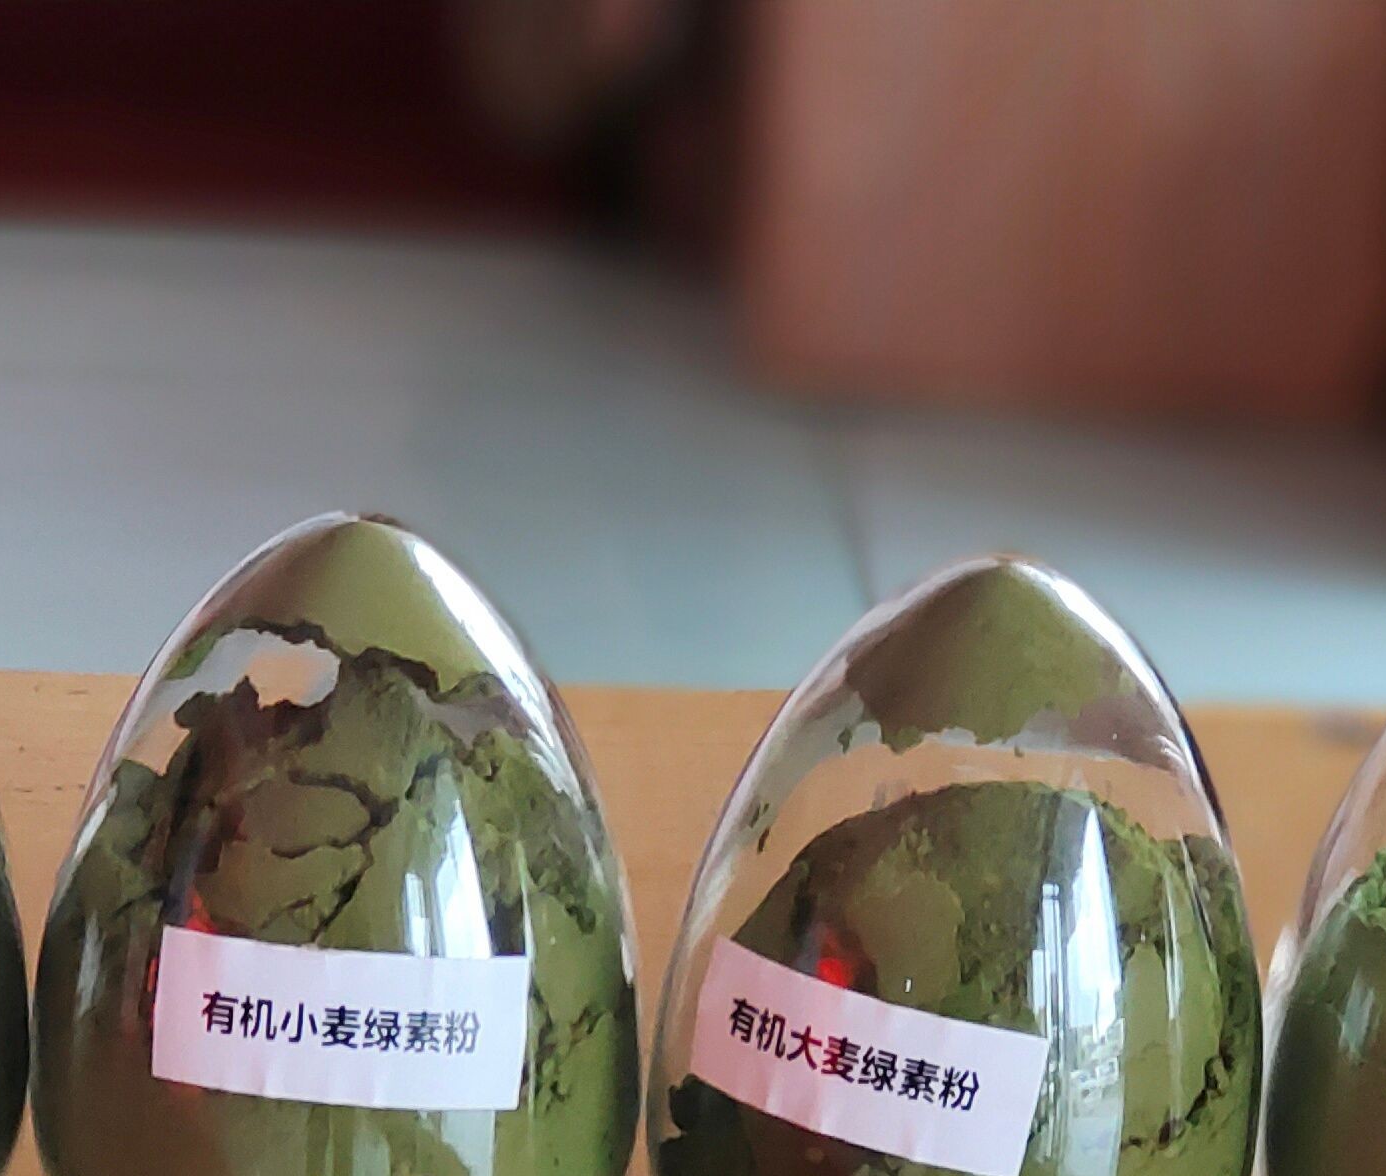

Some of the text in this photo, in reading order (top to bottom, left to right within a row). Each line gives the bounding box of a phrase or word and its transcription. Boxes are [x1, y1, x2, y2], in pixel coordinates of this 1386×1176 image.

[200, 990, 482, 1055] 有机小麦绿素粉
[727, 996, 981, 1112] 有机大麦绿素粉
